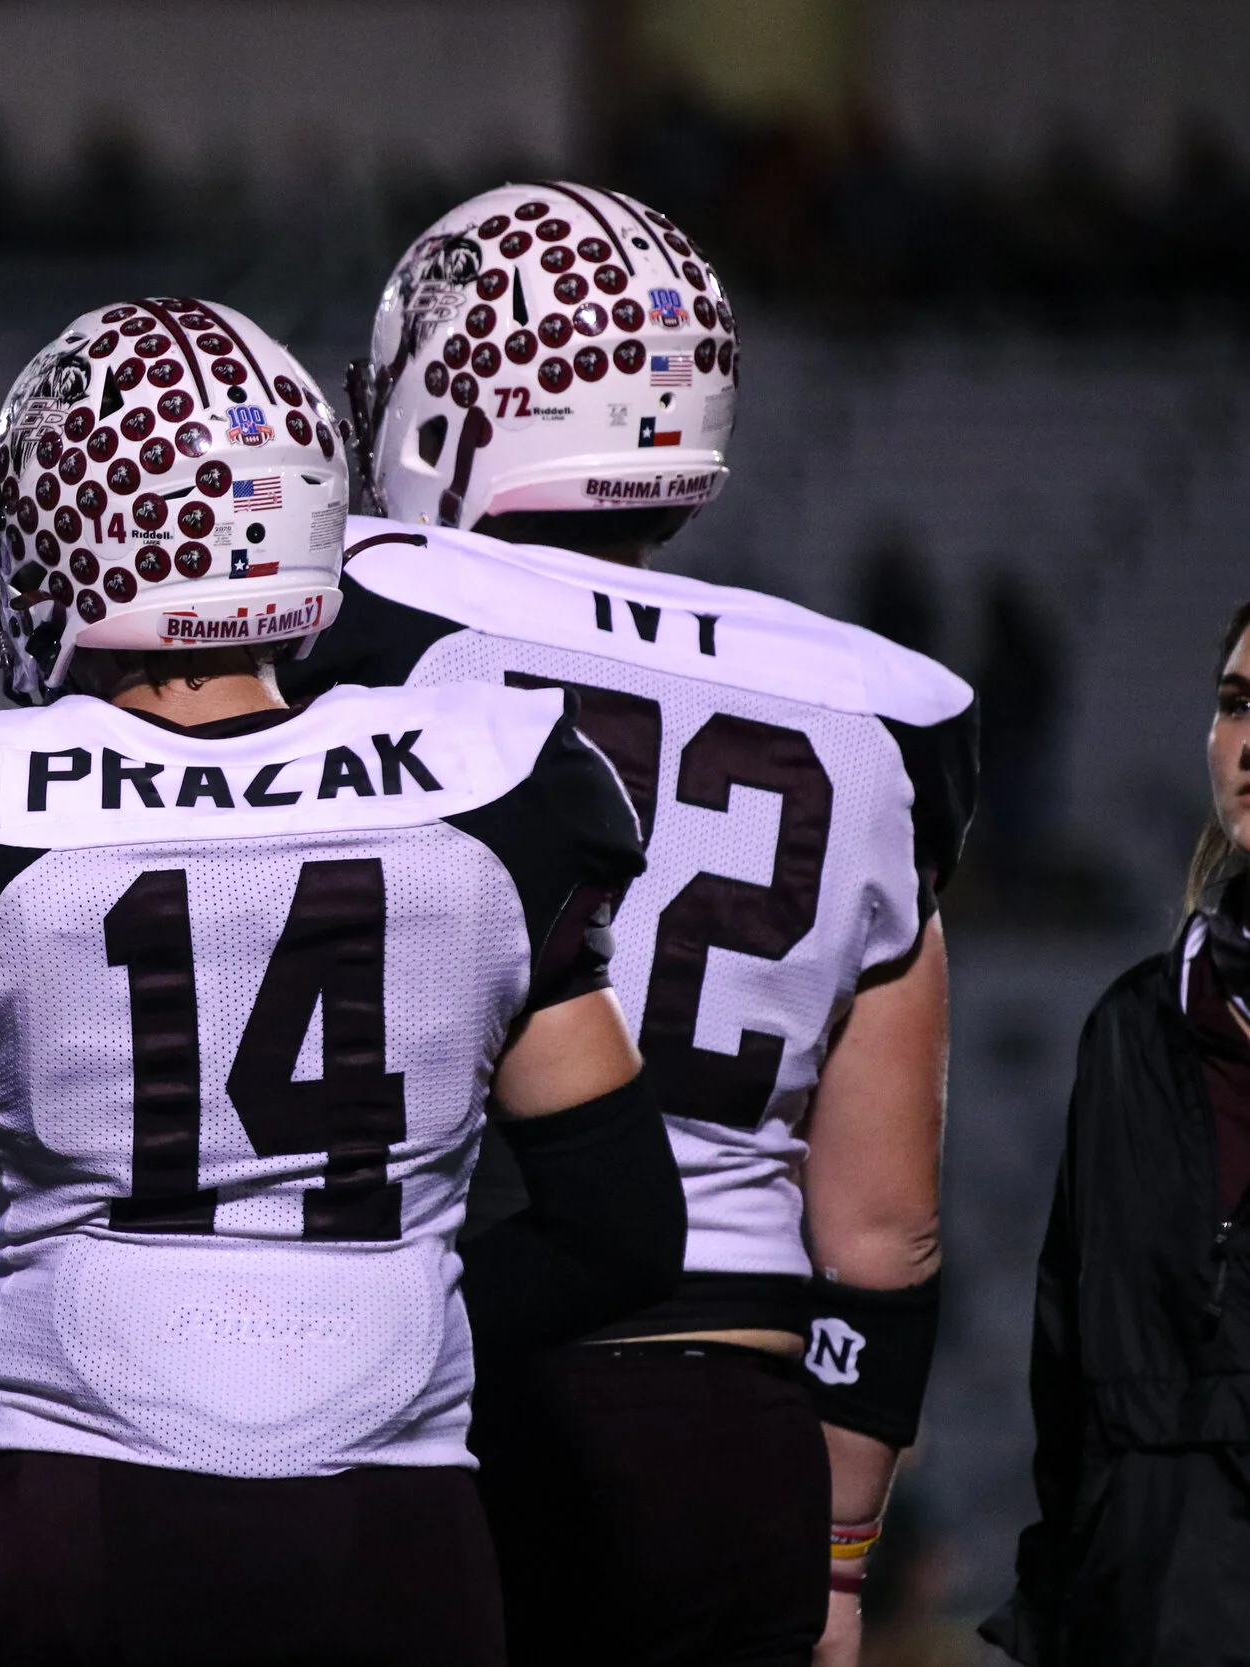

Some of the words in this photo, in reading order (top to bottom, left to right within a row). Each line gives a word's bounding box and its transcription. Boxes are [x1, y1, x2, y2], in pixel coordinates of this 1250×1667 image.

[650, 289, 681, 309] 100
[228, 407, 265, 428] 100
[494, 387, 532, 418] 72
[533, 407, 571, 415] Riddell
[586, 479, 662, 498] BRAHMA
[667, 472, 718, 497] FAMILY
[93, 513, 127, 544] 14
[132, 530, 170, 540] Riddell
[167, 618, 249, 639] BRAHMA
[257, 604, 314, 635] FAMILY
[593, 591, 722, 657] IVY
[28, 729, 445, 812] PRAZAK
[103, 858, 407, 1240] 14
[813, 1328, 857, 1374] N
